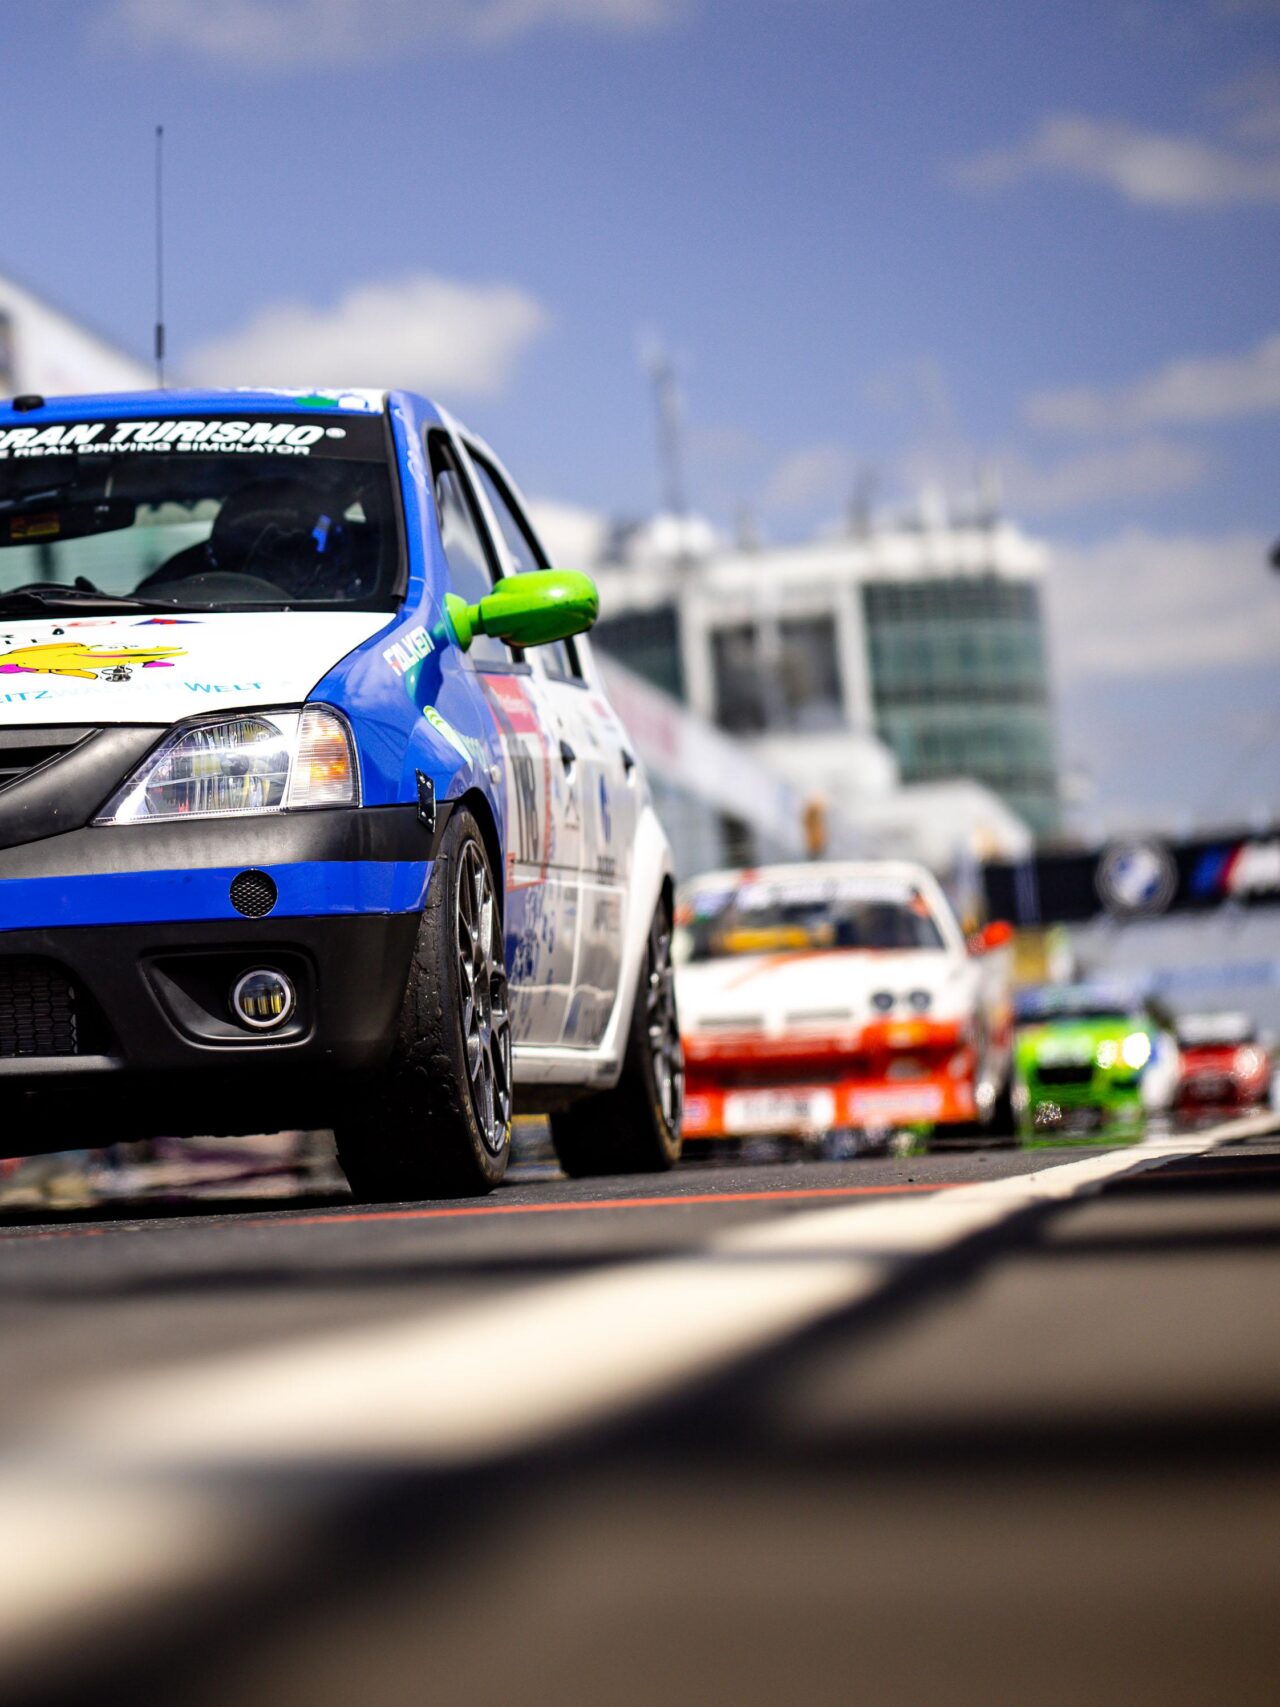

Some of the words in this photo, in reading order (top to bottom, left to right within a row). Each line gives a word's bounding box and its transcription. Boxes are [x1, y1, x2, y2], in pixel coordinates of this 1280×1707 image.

[114, 421, 325, 446] TURISMO
[15, 446, 73, 458] REAL
[77, 442, 169, 455] DRIVING
[176, 442, 310, 455] SIMULATOR
